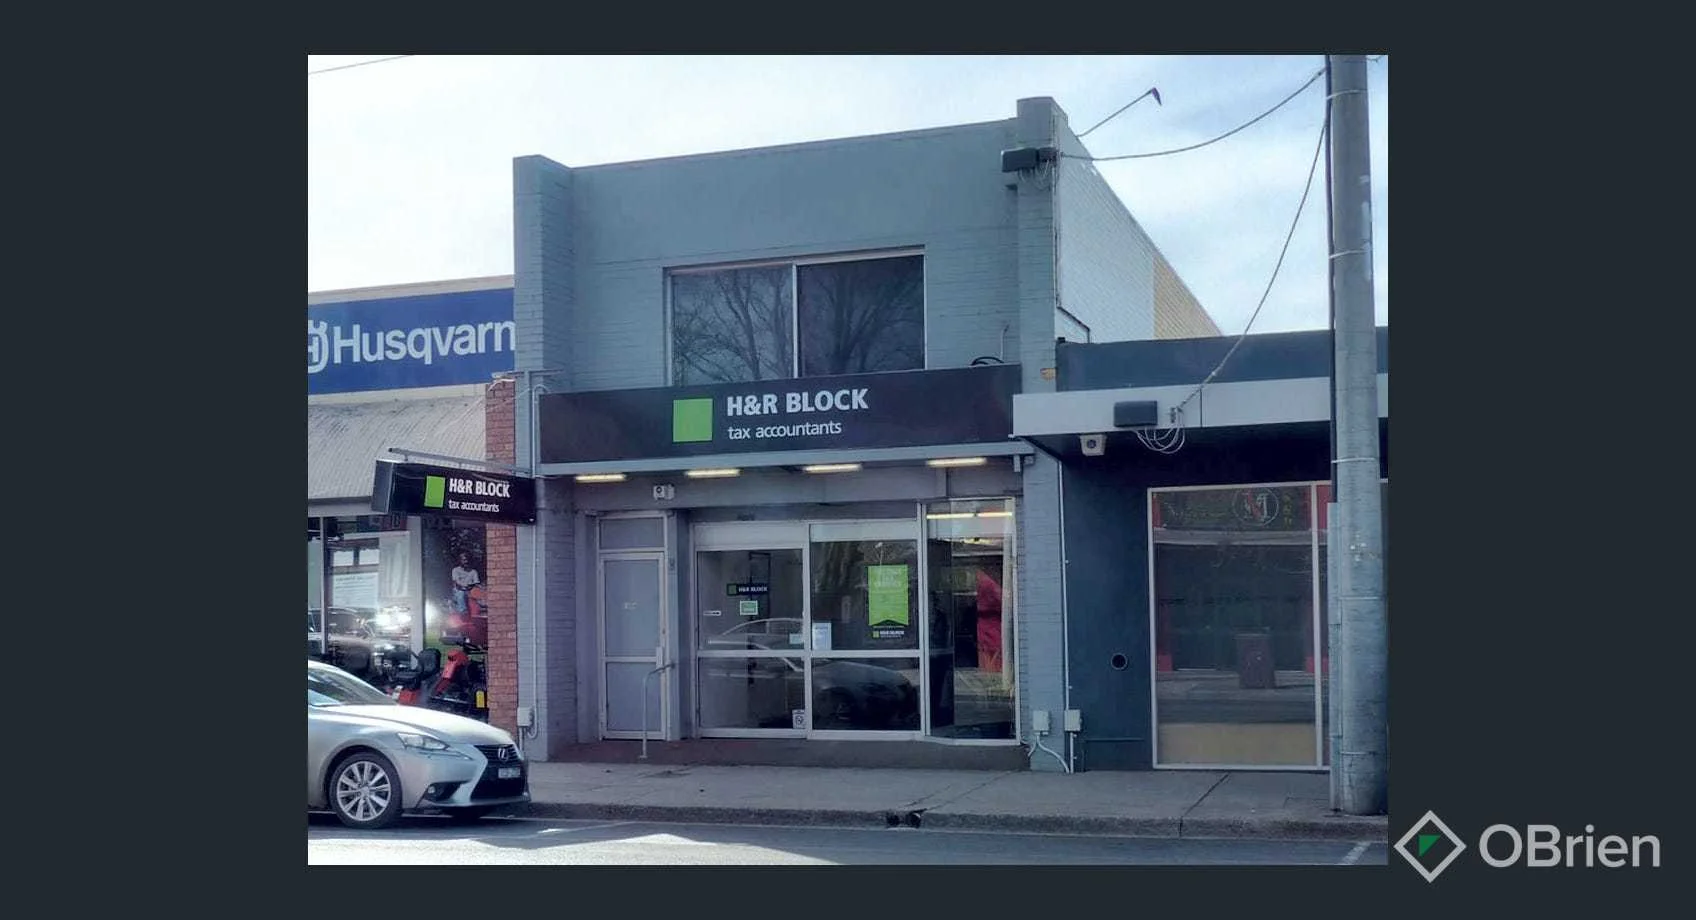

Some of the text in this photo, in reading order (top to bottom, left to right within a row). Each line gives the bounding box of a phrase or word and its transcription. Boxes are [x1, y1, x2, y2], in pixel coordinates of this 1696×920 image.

[333, 321, 516, 365] Husqvarn
[727, 388, 869, 416] H&R BLOCK
[728, 420, 842, 440] tax accountants
[449, 478, 511, 498] H&R BLOCK
[448, 499, 500, 513] tax accountants
